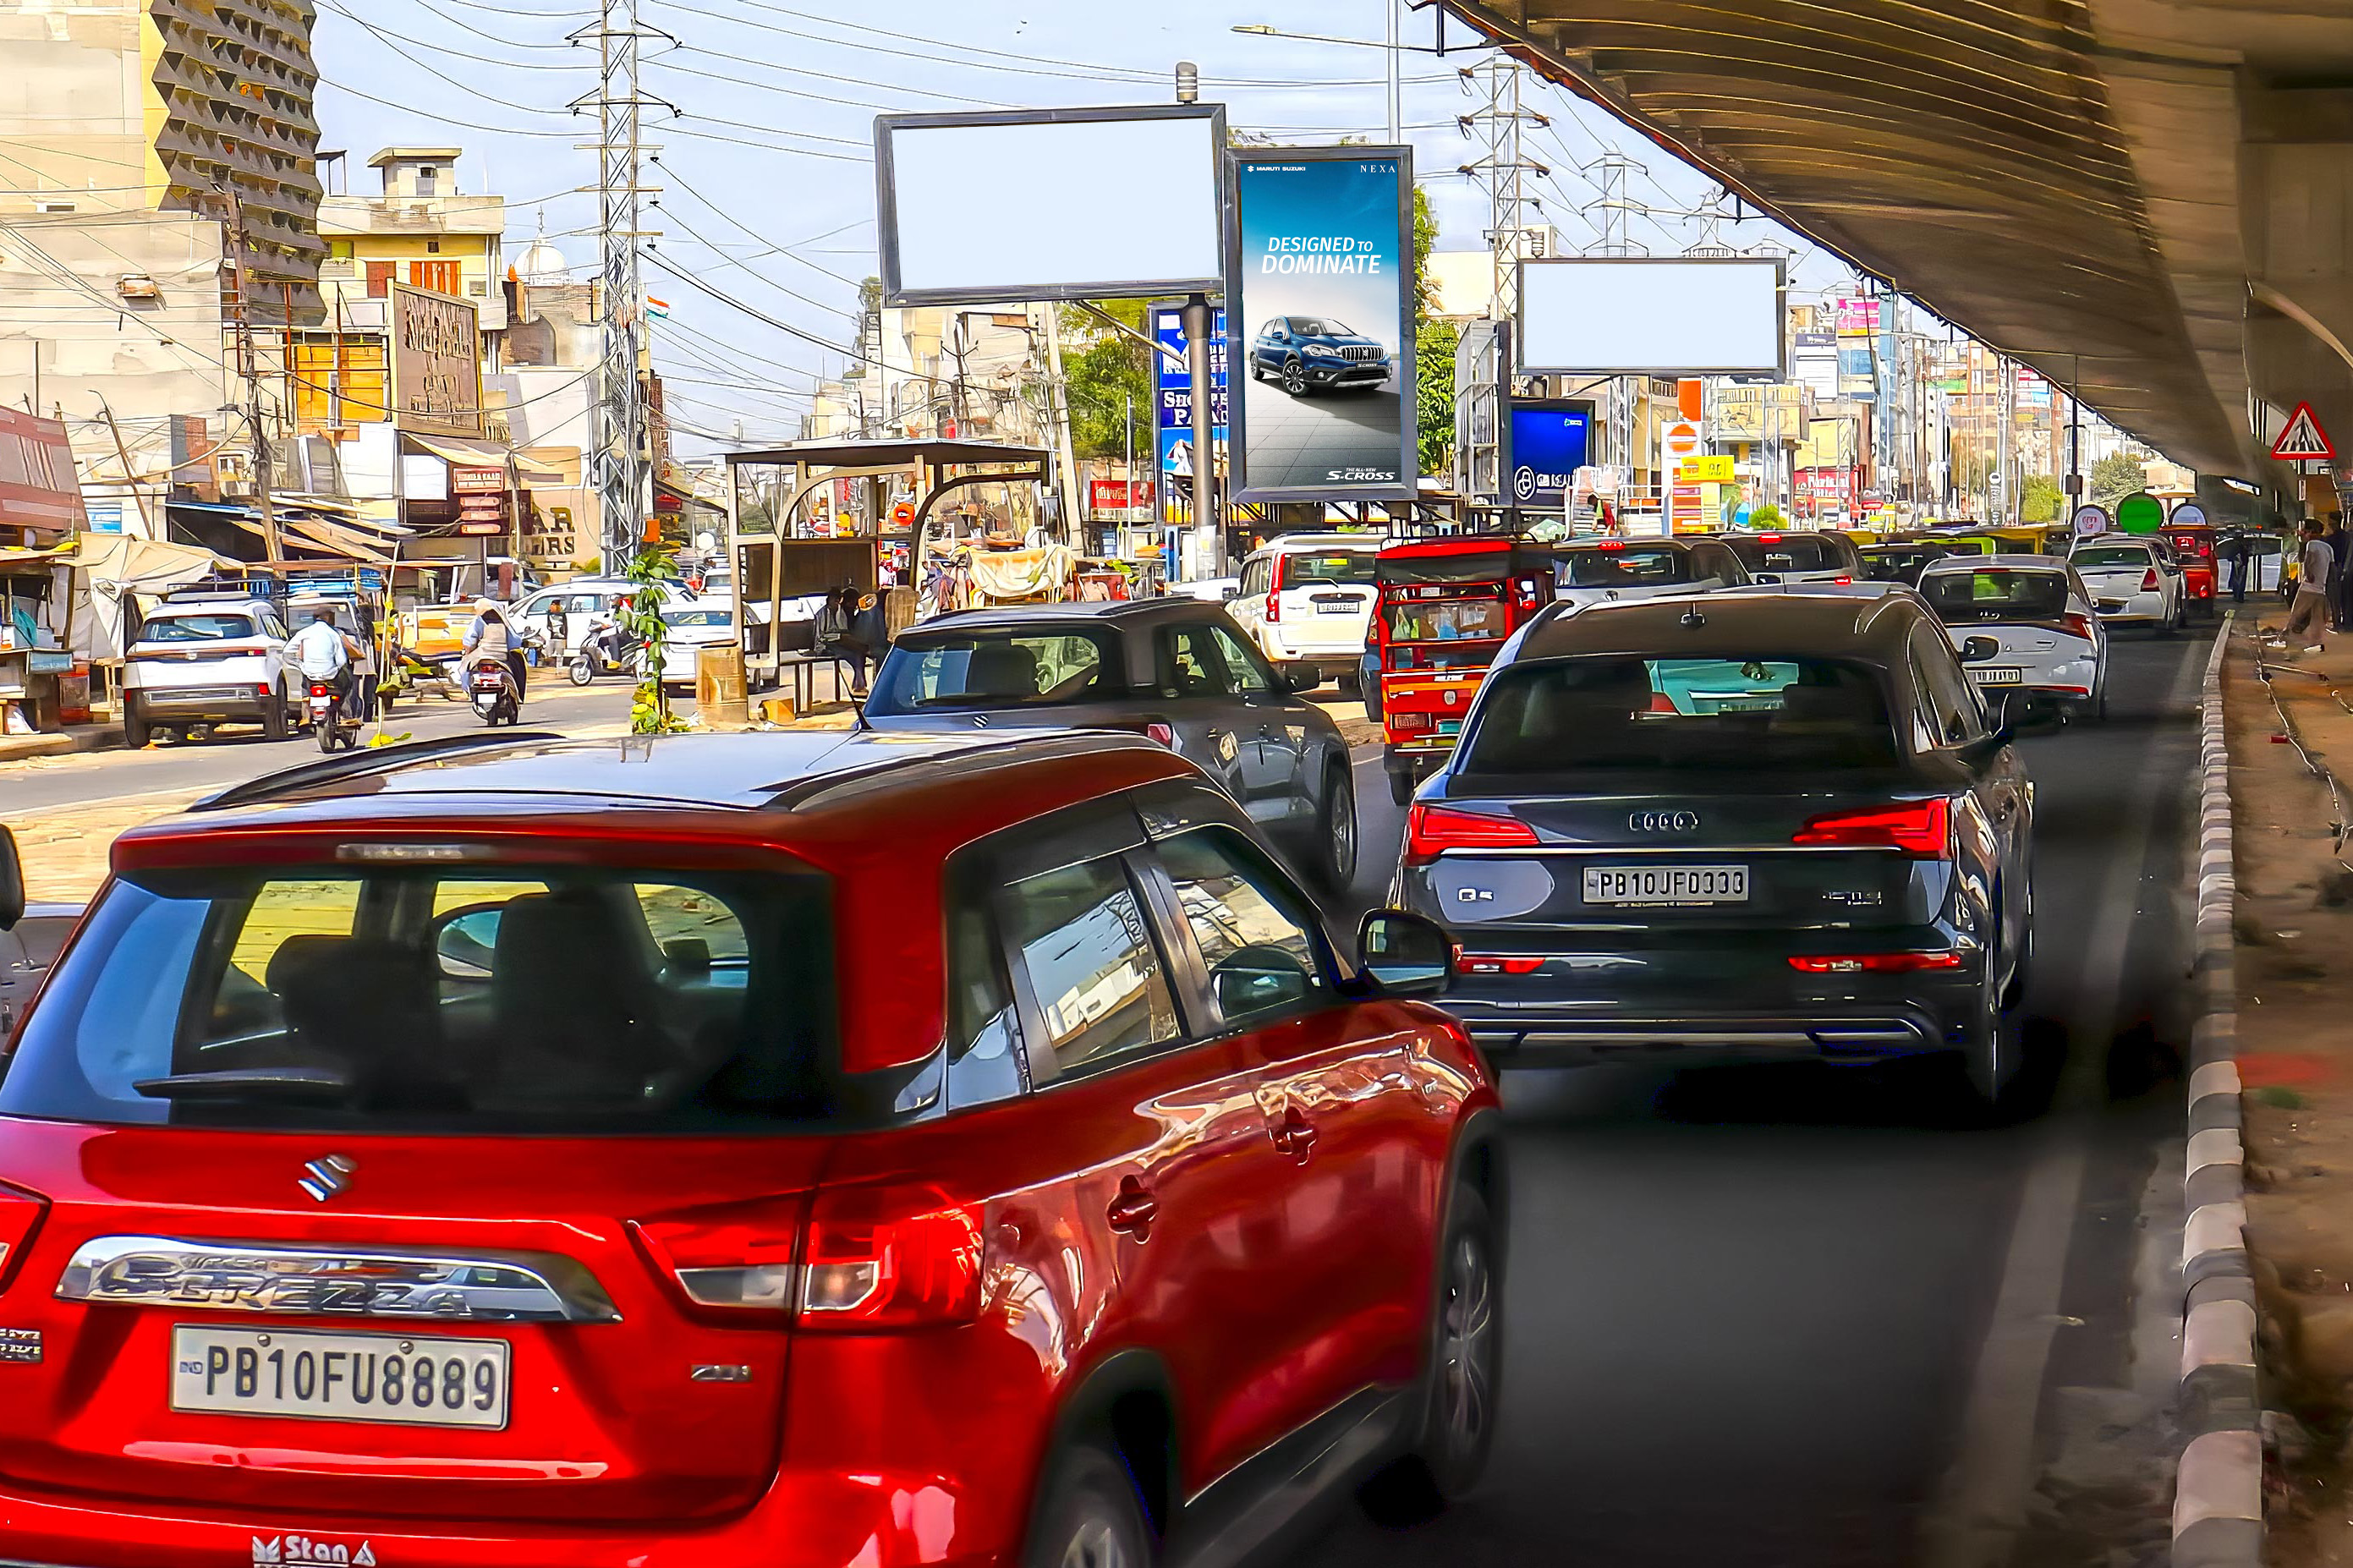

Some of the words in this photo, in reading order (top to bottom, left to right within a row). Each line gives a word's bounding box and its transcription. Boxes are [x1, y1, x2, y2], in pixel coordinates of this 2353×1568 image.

[1360, 165, 1396, 173] NEXA
[1268, 236, 1355, 252] DESIGNED
[1357, 241, 1374, 252] TO
[1261, 254, 1382, 275] DOMINATE
[1325, 470, 1396, 480] S-CROSS
[206, 1345, 496, 1412] PB10FU8889
